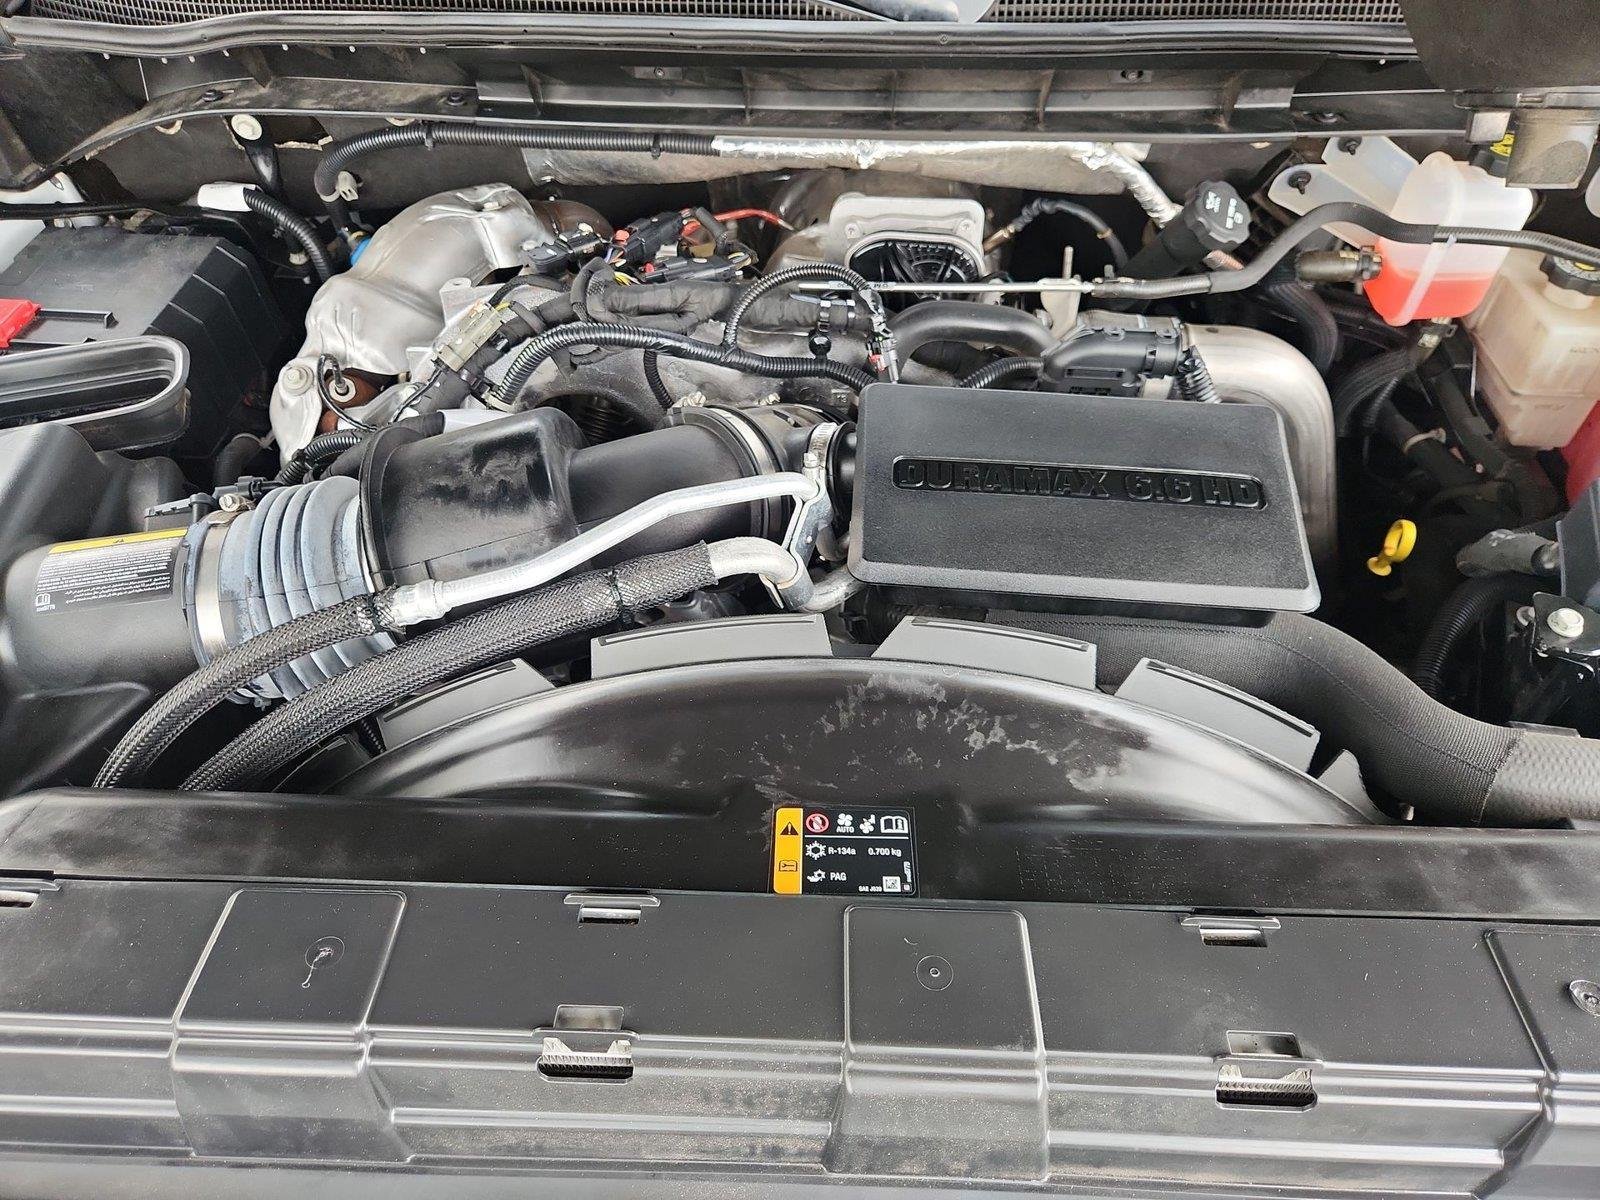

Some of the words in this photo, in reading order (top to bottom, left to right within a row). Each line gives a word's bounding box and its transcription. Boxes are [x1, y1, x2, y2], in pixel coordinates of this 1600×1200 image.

[899, 460, 1110, 498] DURAMAX
[1125, 472, 1193, 503] 6.6
[1202, 477, 1260, 508] HD
[828, 847, 857, 855] R-134a
[868, 847, 890, 856] 0.700
[891, 848, 902, 857] kg
[830, 872, 847, 881] PAG
